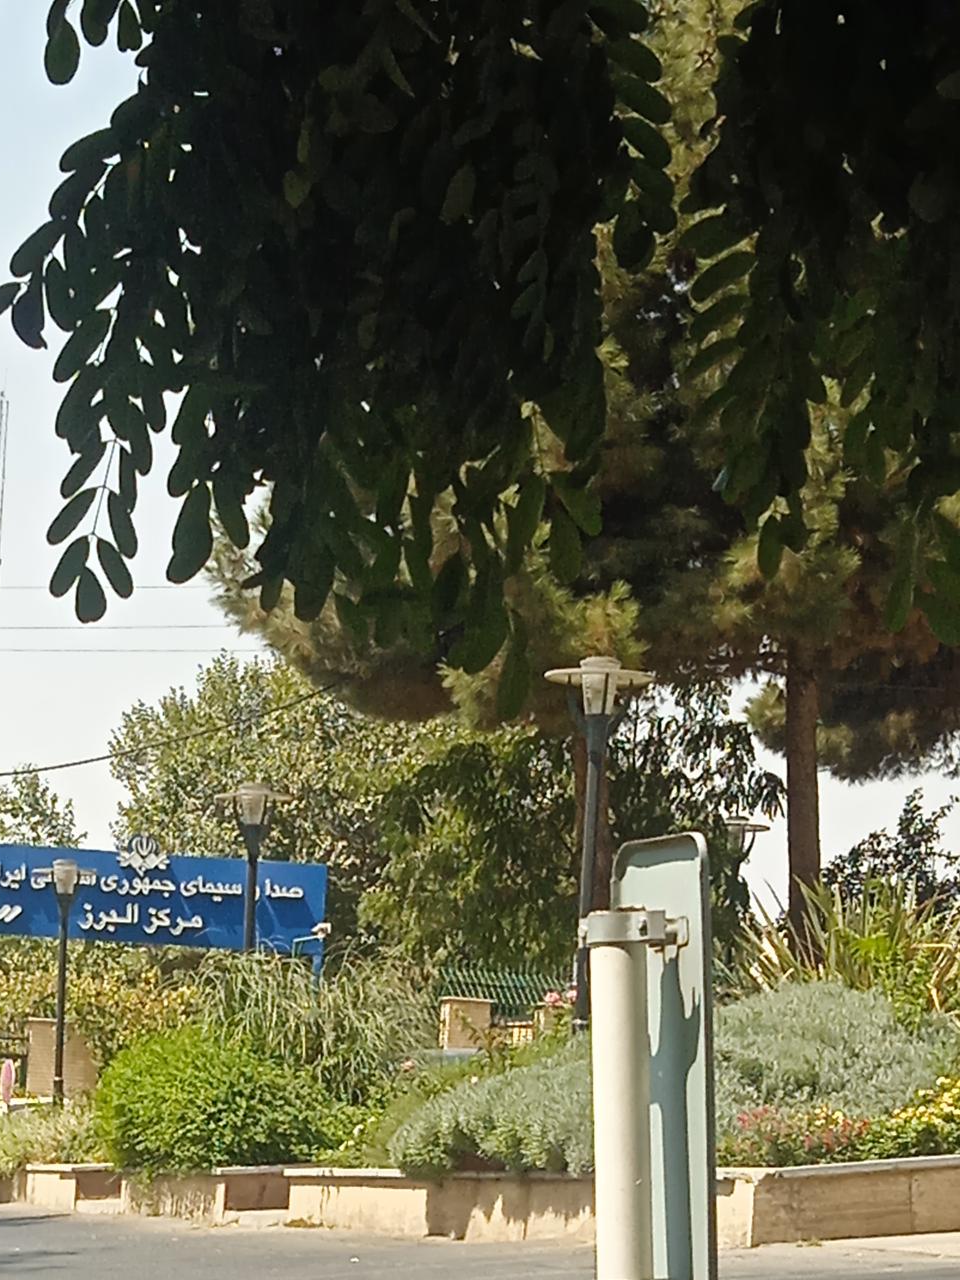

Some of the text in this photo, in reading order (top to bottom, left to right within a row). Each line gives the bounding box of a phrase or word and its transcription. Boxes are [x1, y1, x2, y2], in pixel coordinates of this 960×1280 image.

[100, 874, 176, 898] جمهوری
[179, 875, 243, 902] سیمای
[264, 877, 304, 899] صدا
[77, 902, 203, 936] مرکز البرز
